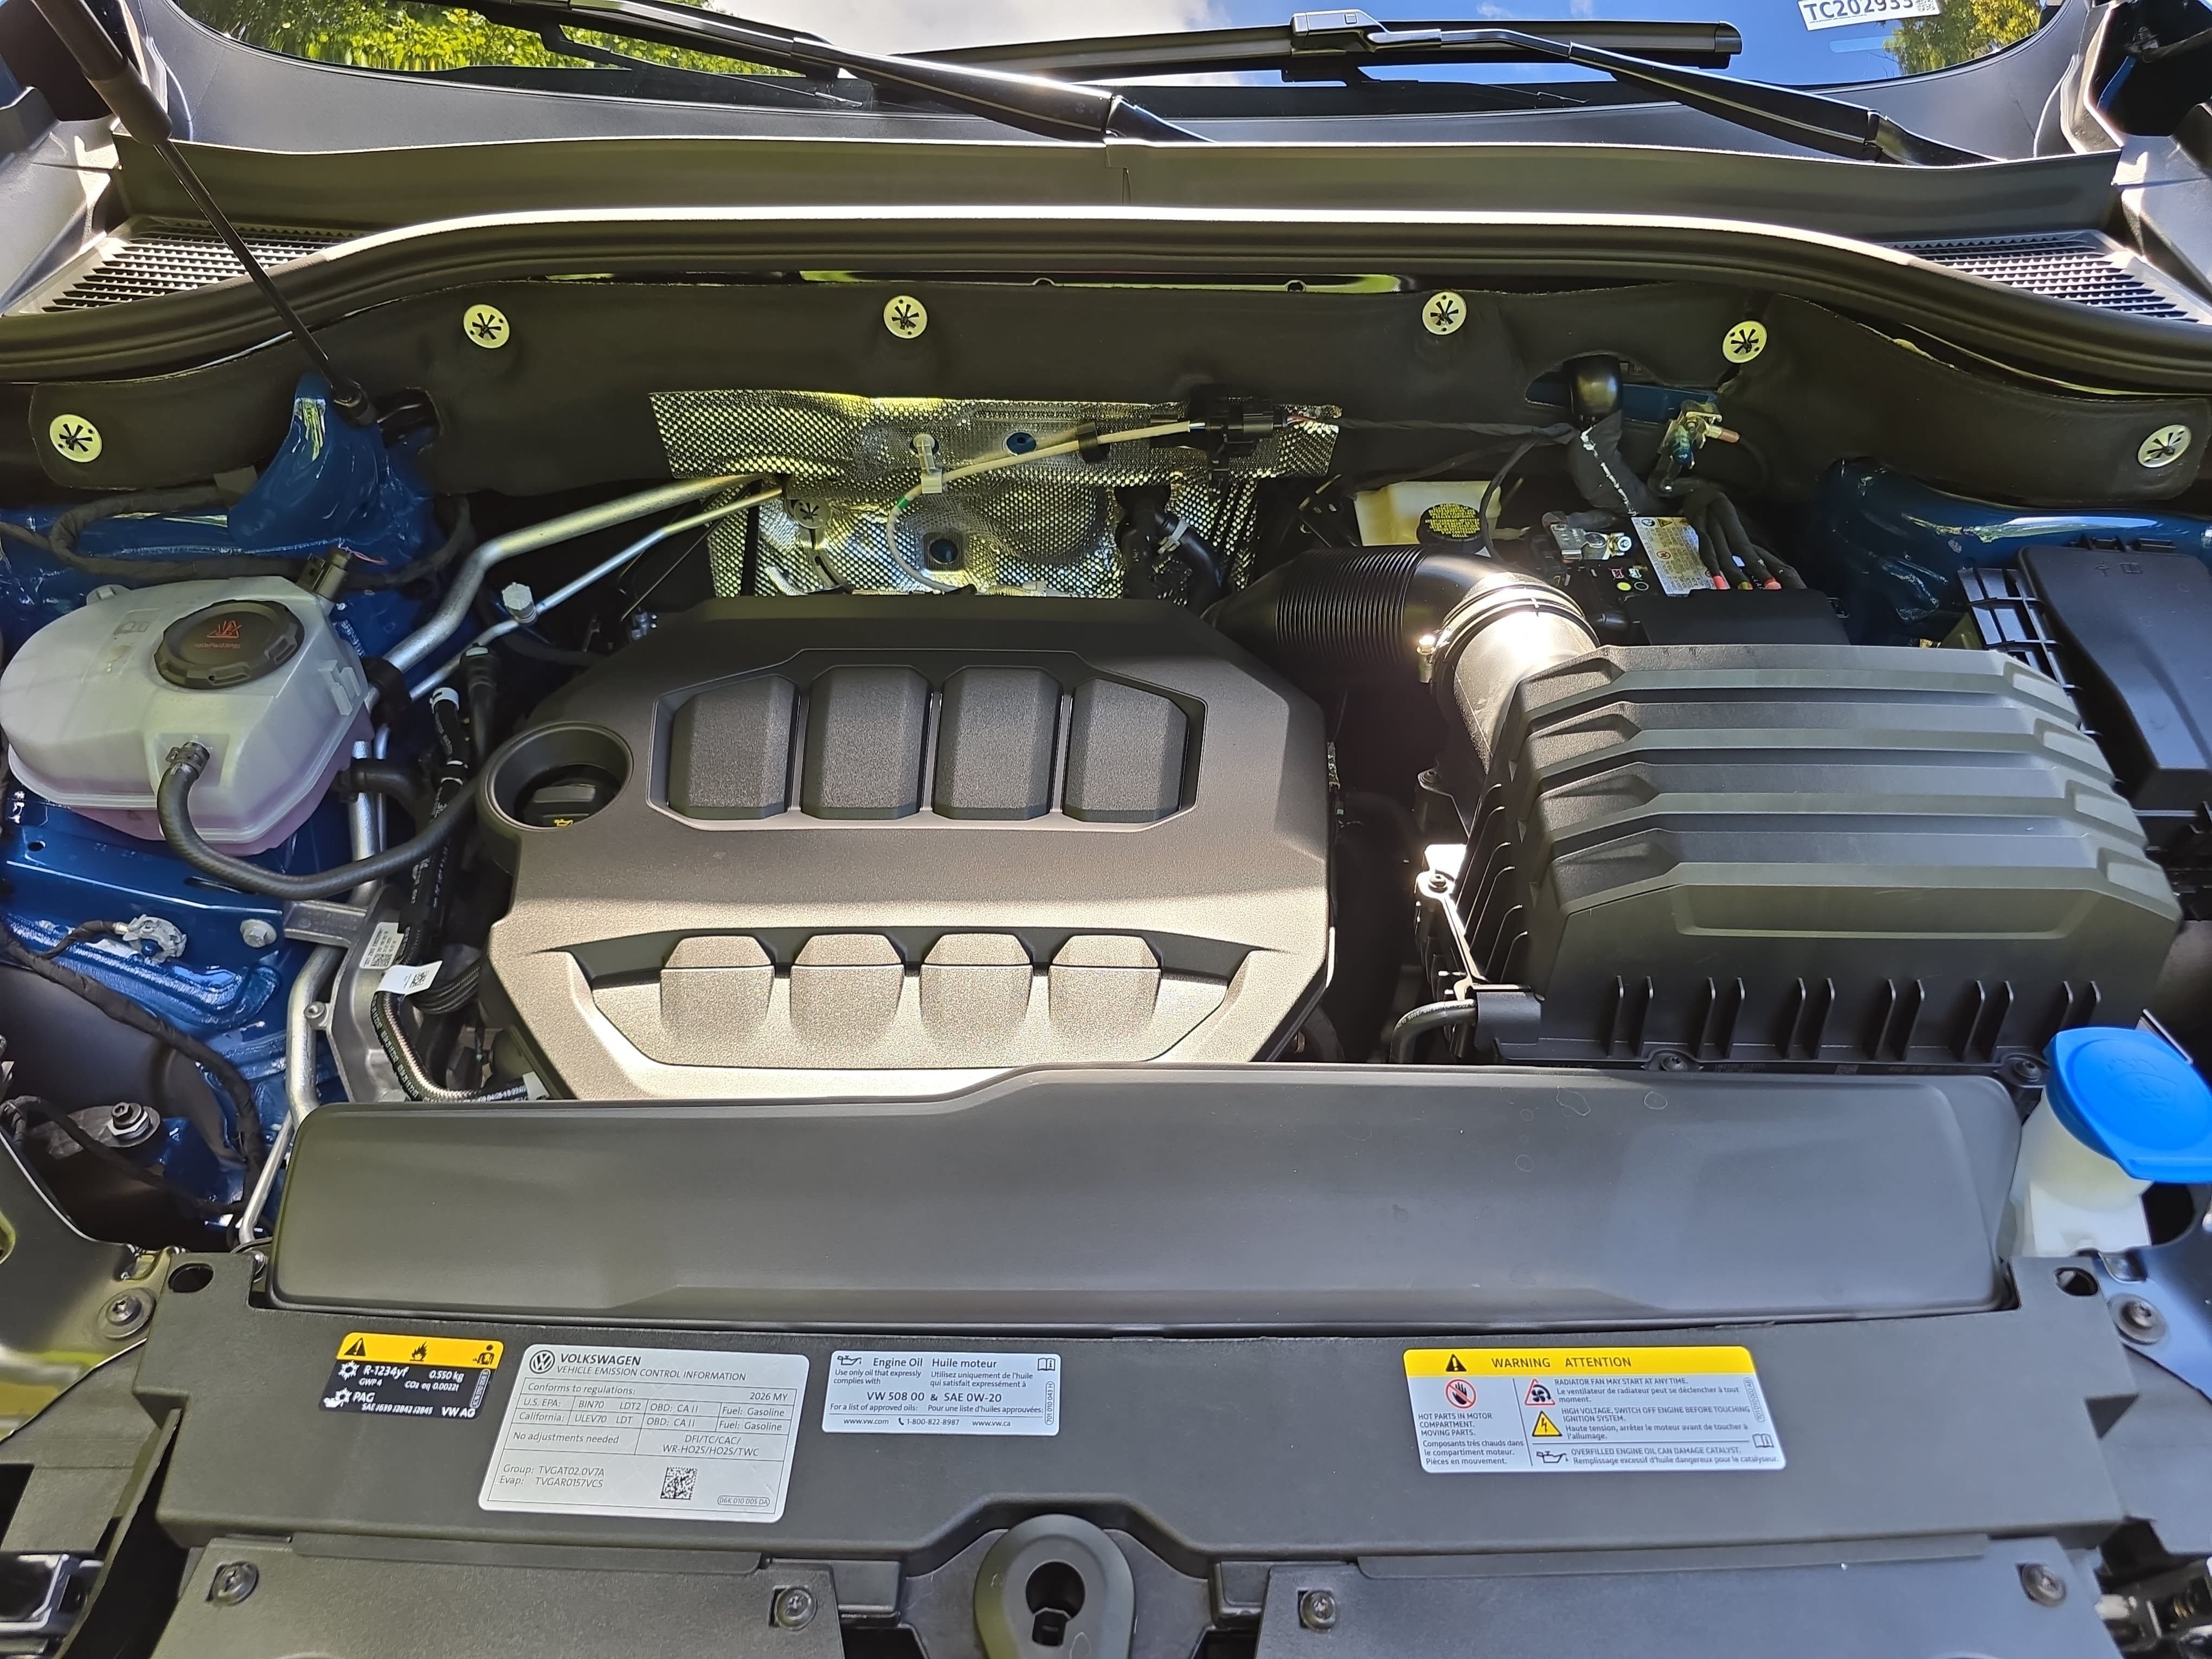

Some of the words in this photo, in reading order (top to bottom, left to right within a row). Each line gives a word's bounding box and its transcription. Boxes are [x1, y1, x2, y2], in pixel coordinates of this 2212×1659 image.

[561, 1353, 641, 1365] VOLKSWAGEN
[873, 1357, 906, 1369] Engine
[909, 1357, 923, 1367] Oil
[932, 1358, 958, 1367] Huile
[960, 1359, 998, 1368] moteur
[1491, 1358, 1551, 1368] WARNING
[1565, 1356, 1632, 1367] ATTENTION
[363, 1365, 409, 1379] R-1234yf
[428, 1369, 453, 1380] 0.550
[452, 1371, 465, 1383] kg
[557, 1365, 593, 1374] VEHICLE
[594, 1367, 638, 1377] EMISSION
[640, 1368, 680, 1378] CONTROL
[683, 1371, 747, 1381] INFORMATION
[848, 1368, 864, 1378] only
[890, 1369, 922, 1379] expressly
[958, 1371, 1001, 1381] uniquement
[421, 1382, 431, 1392] eq
[432, 1381, 459, 1392] 0.0022t
[833, 1377, 864, 1386] complies
[930, 1379, 942, 1388] qui
[972, 1380, 1020, 1389] expressément
[528, 1382, 570, 1392] Conforms
[572, 1384, 582, 1392] to
[583, 1385, 636, 1397] regulations:
[1046, 1390, 1054, 1400] 043
[1651, 1387, 1668, 1396] peut
[352, 1391, 376, 1404] PAG
[749, 1392, 771, 1400] 2026
[773, 1393, 788, 1401] MY
[867, 1391, 886, 1401] VW
[888, 1392, 908, 1401] 508
[910, 1392, 925, 1401] 00
[930, 1393, 938, 1401] &
[944, 1392, 963, 1402] SAE
[966, 1393, 1002, 1403] 0W-20
[441, 1406, 461, 1417] VW
[459, 1406, 477, 1418] AG
[523, 1398, 540, 1406] U.S.
[542, 1398, 561, 1410] EPA:
[578, 1400, 605, 1409] BIN70
[619, 1401, 641, 1411] LDT2
[650, 1403, 673, 1412] OBD:
[677, 1404, 689, 1413] CA
[722, 1406, 743, 1415] Fuel:
[747, 1407, 785, 1417] Gasoline
[848, 1403, 859, 1411] list
[869, 1404, 903, 1413] approved
[1002, 1406, 1044, 1414] approuvées:
[1713, 1405, 1751, 1413] TOUCHING
[519, 1411, 564, 1422] California:
[575, 1413, 607, 1423] ULEV70
[616, 1416, 634, 1424] LDT
[646, 1417, 670, 1426] OBD:
[673, 1418, 686, 1427] CA
[719, 1420, 740, 1430] Fuel:
[744, 1421, 782, 1431] Gasoline
[1589, 1424, 1618, 1433] tension,
[1619, 1423, 1644, 1431] arrêter
[513, 1431, 526, 1440] No
[528, 1432, 584, 1443] adjustments
[586, 1435, 620, 1444] needed
[684, 1435, 742, 1446] DFI/TC/CAC/
[1567, 1432, 1607, 1441] l'allumage.
[1423, 1439, 1466, 1449] Composants
[1432, 1447, 1484, 1457] compartiment
[1571, 1448, 1615, 1456] OVERFILLED
[1705, 1446, 1741, 1454] CATALYST.
[1573, 1456, 1619, 1466] Remplissage
[1619, 1456, 1648, 1464] excessif
[503, 1464, 534, 1476] Group:
[499, 1475, 524, 1487] Evap:
[718, 1496, 732, 1504] 06K
[758, 1497, 769, 1507] DA
